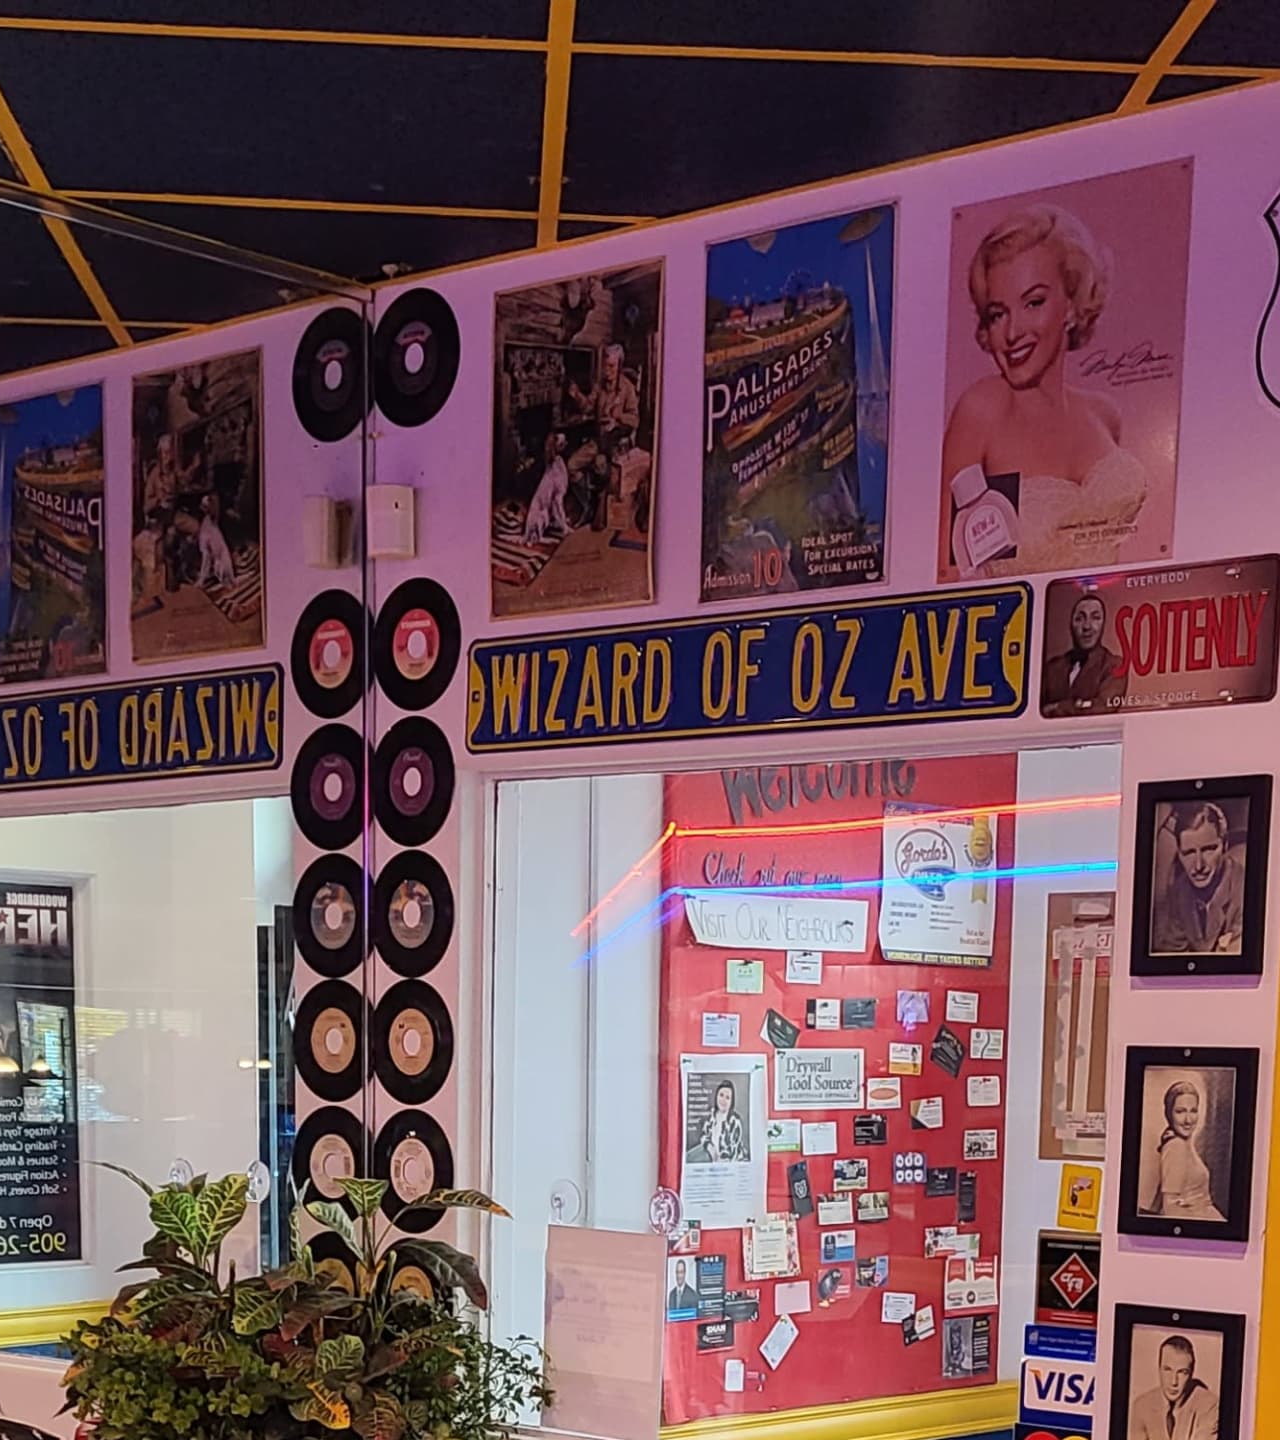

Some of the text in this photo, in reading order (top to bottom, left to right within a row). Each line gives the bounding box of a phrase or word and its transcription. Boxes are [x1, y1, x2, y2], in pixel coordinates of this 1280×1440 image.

[706, 329, 833, 453] PALISADES
[728, 374, 800, 427] AMUSEMENT
[830, 531, 853, 543] SPOT
[752, 547, 783, 588] 10
[846, 559, 875, 571] RATES
[1126, 571, 1192, 588] EVERYBODY
[1111, 589, 1271, 677] SOITENLY
[490, 604, 998, 735] WIZARD OF OZ AVE
[1106, 695, 1139, 708] LOVES
[1153, 690, 1198, 703] STOOGE
[786, 1056, 832, 1078] Drywall
[785, 1074, 853, 1090] Tool Source
